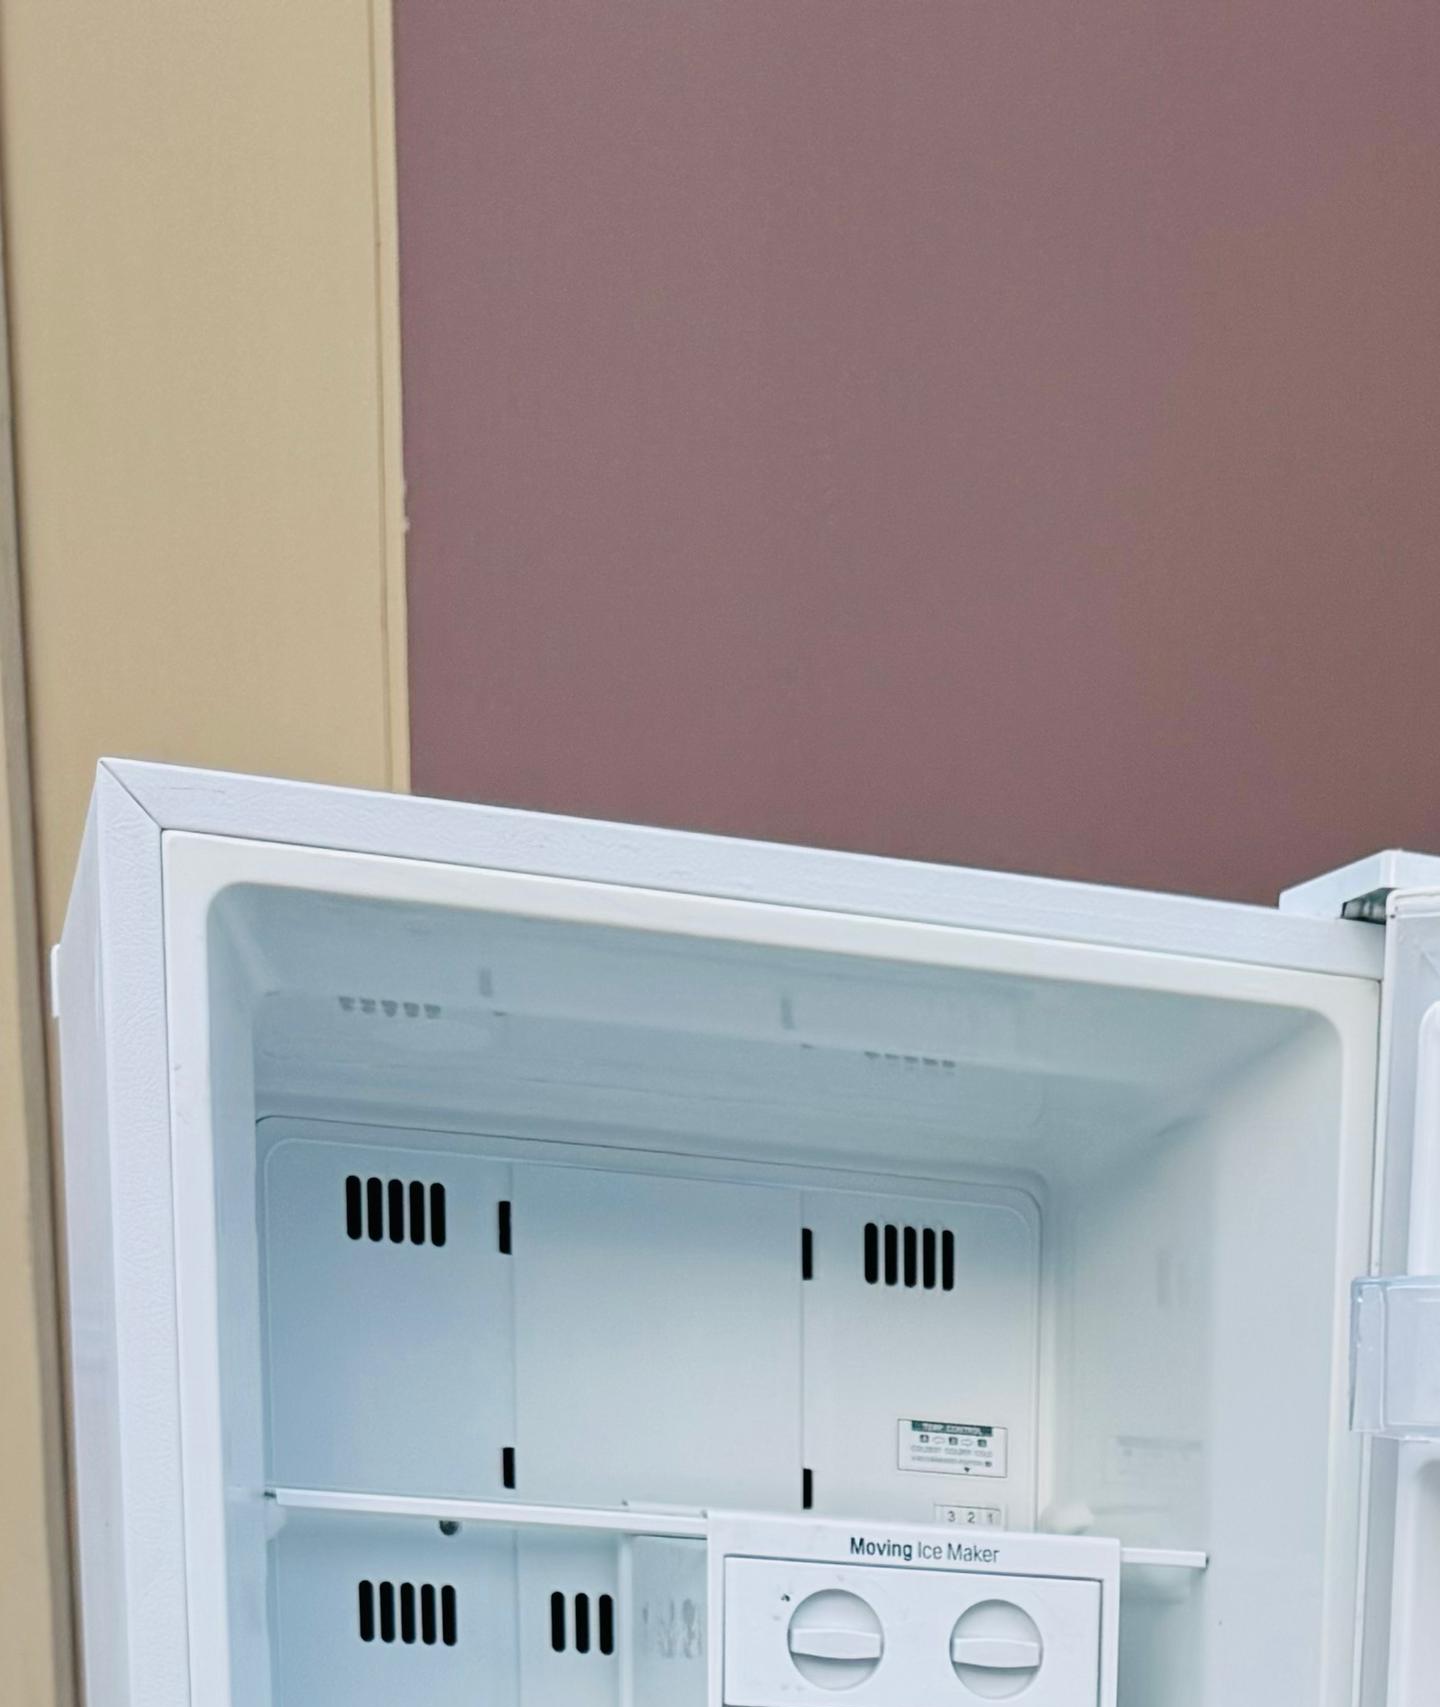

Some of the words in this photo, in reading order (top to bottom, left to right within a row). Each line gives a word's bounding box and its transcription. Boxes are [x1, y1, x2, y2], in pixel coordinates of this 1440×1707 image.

[948, 1511, 956, 1522] 3
[967, 1512, 976, 1524] 2
[850, 1536, 913, 1562] Moving
[918, 1541, 943, 1560] Ice
[948, 1543, 1000, 1563] Maker
